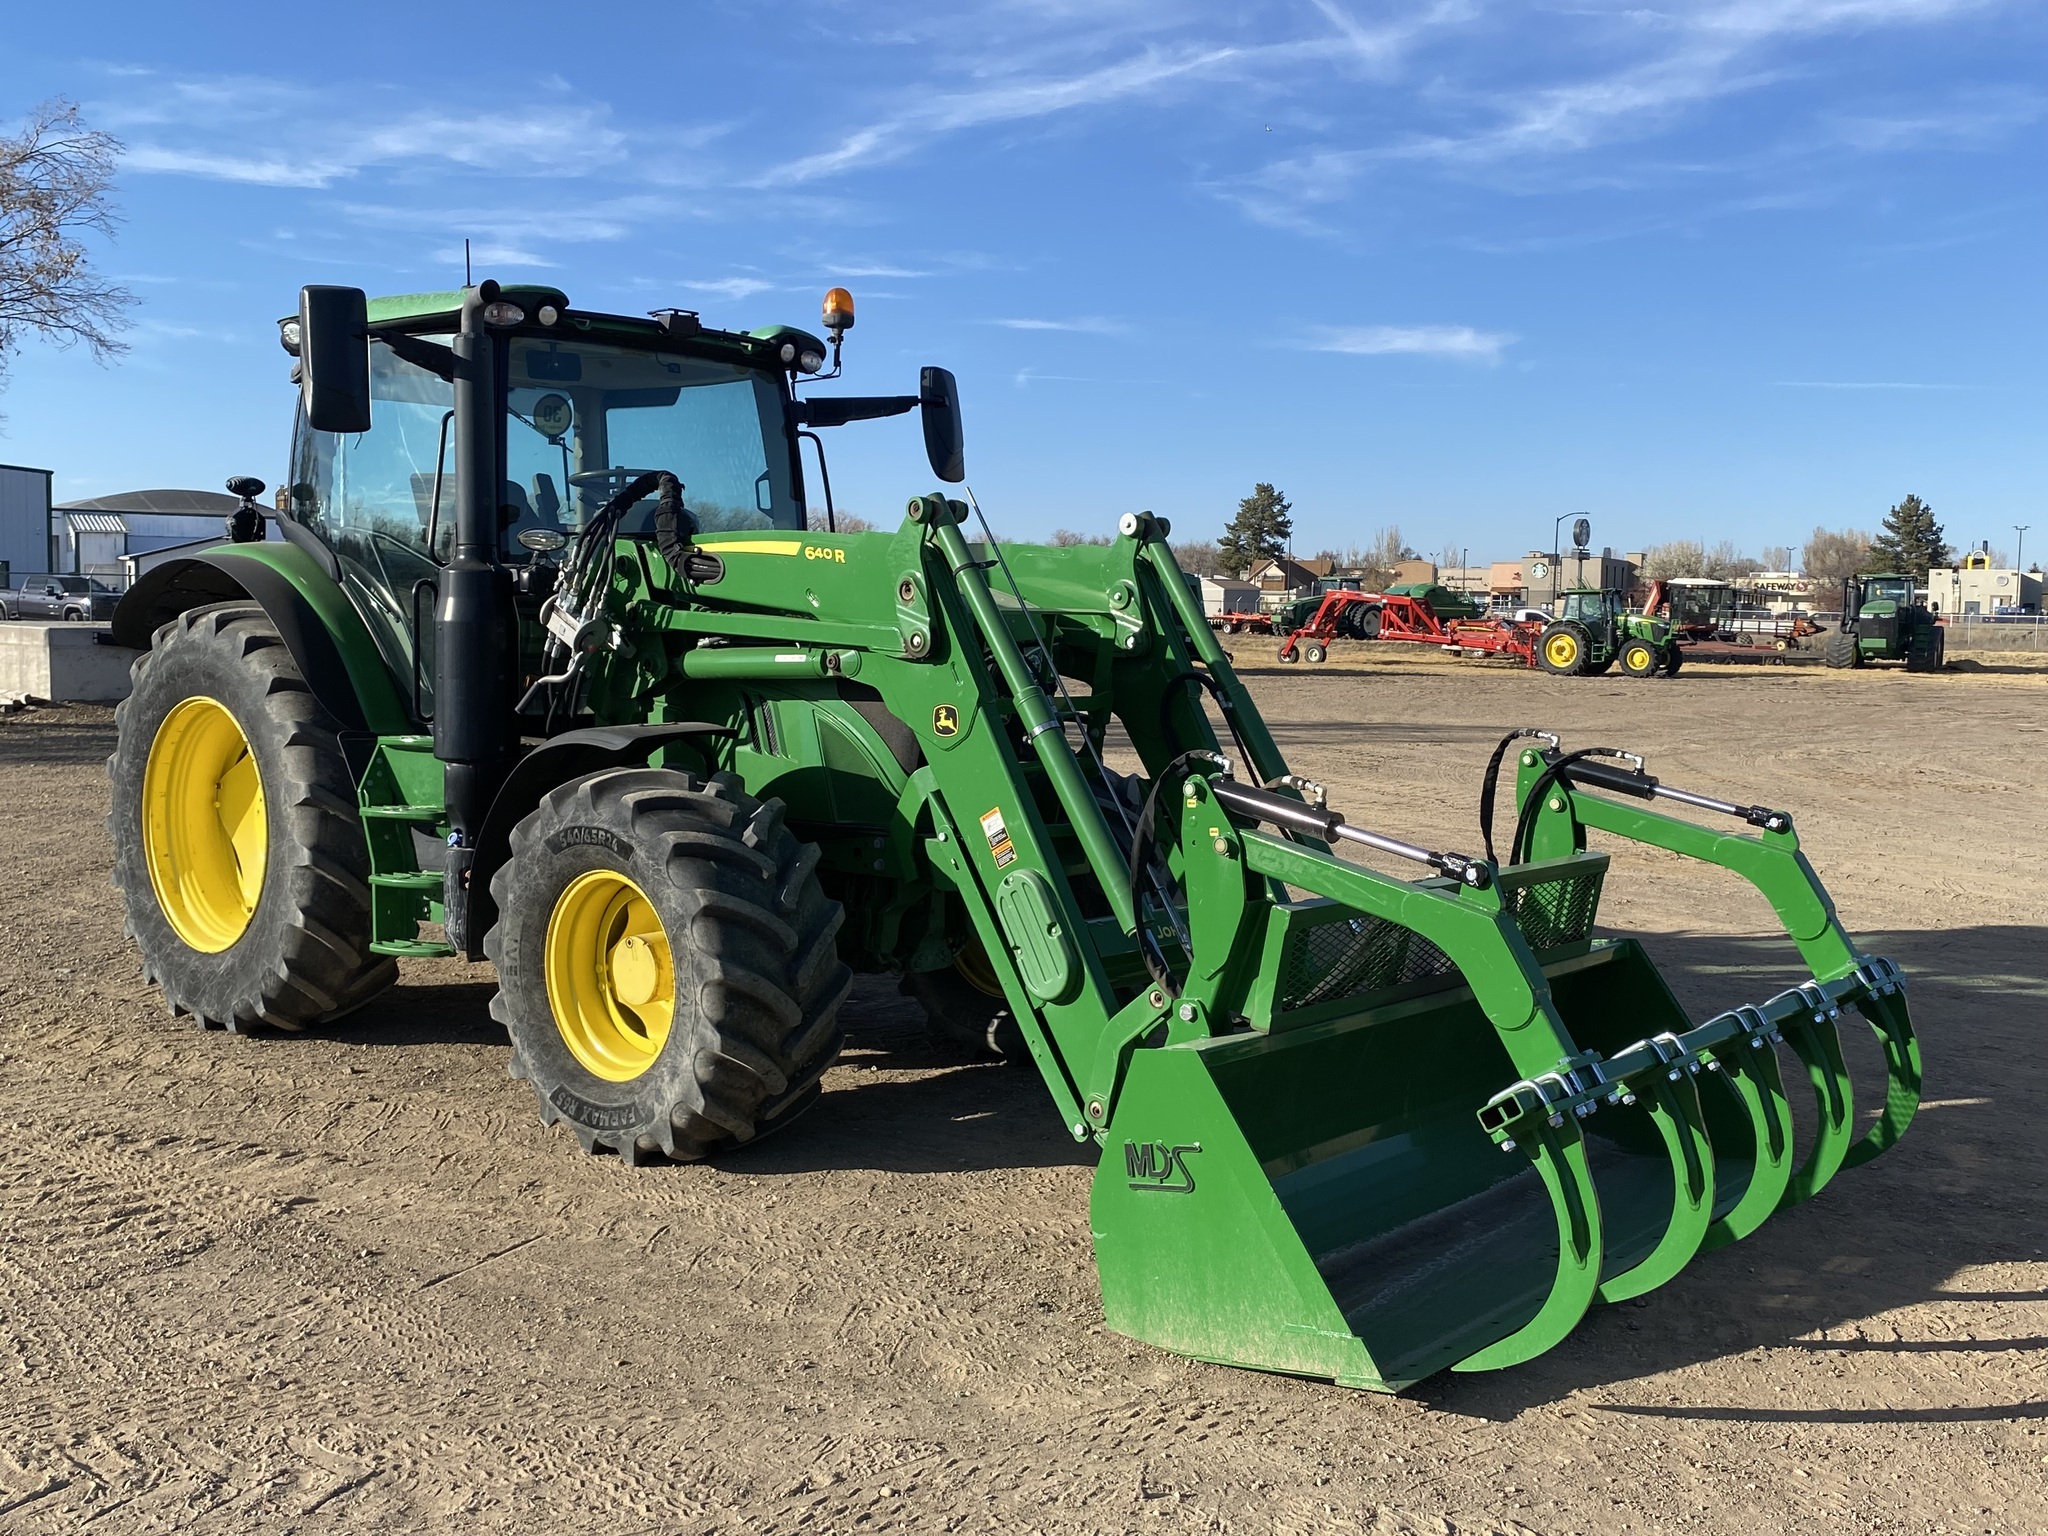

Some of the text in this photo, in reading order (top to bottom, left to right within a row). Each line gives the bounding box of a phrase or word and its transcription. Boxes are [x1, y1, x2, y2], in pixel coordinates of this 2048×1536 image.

[1754, 582, 1796, 591] SAFEWAY
[560, 827, 618, 852] 540/65R24
[556, 1092, 636, 1127] FARMAX R65
[1124, 1141, 1203, 1194] MDS
